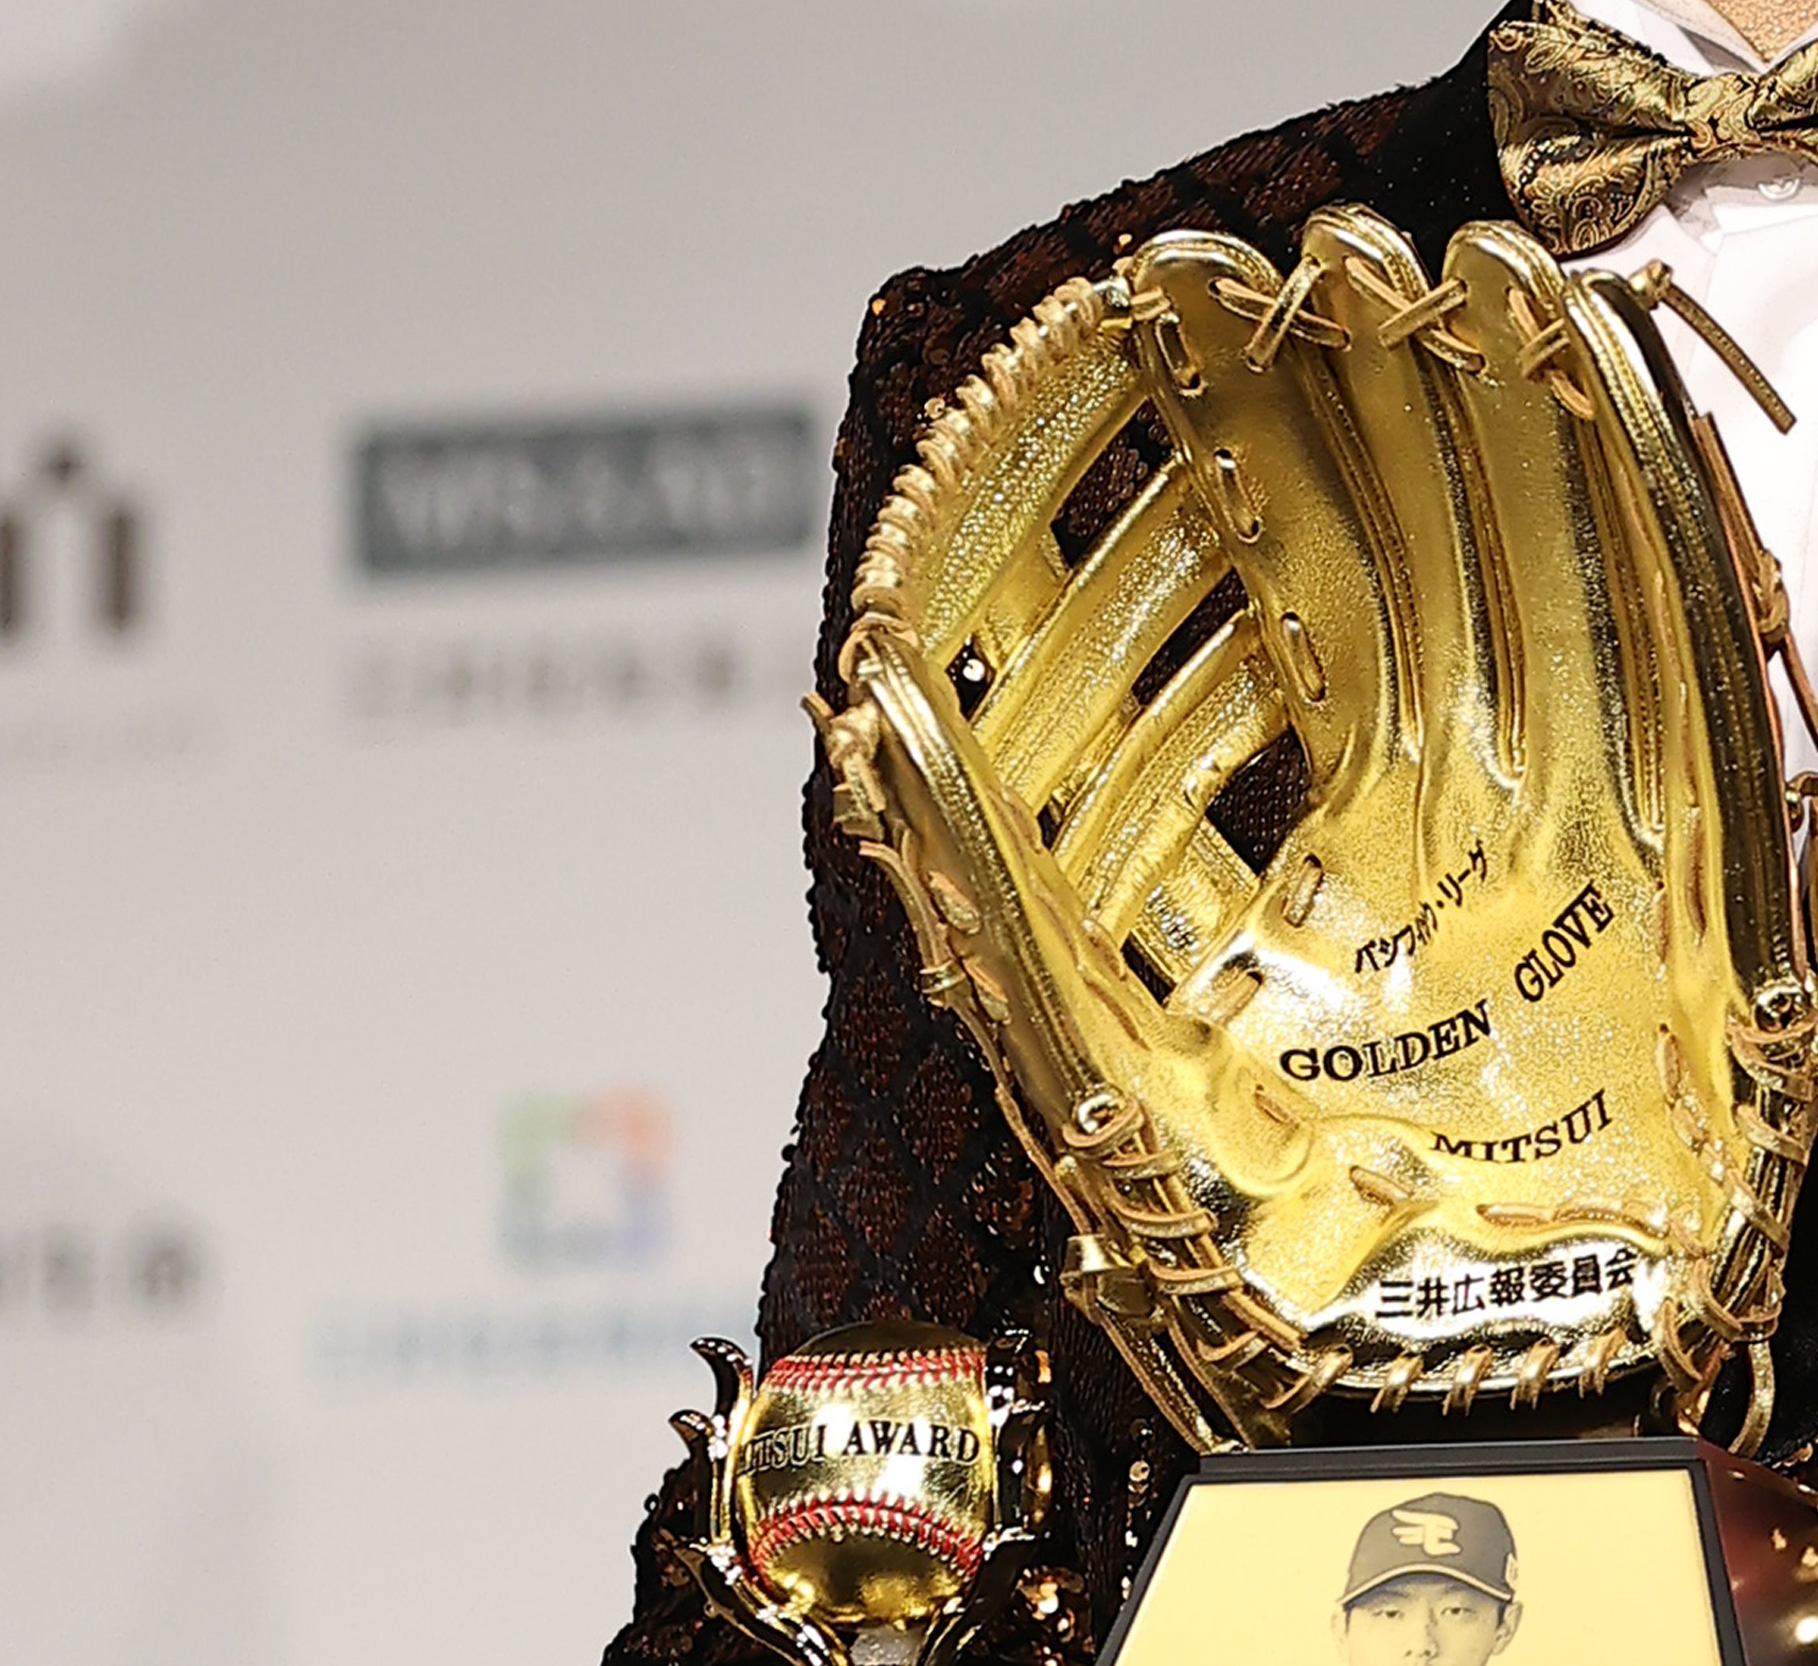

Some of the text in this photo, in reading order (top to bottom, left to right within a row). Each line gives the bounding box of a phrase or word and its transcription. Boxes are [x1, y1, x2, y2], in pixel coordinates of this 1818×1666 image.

[1280, 880, 1614, 1082] GOLDEN GLOVE
[1430, 1089, 1613, 1164] MITSUI
[1375, 1247, 1637, 1318] 三井広報委員会
[843, 1419, 981, 1465] AWARD
